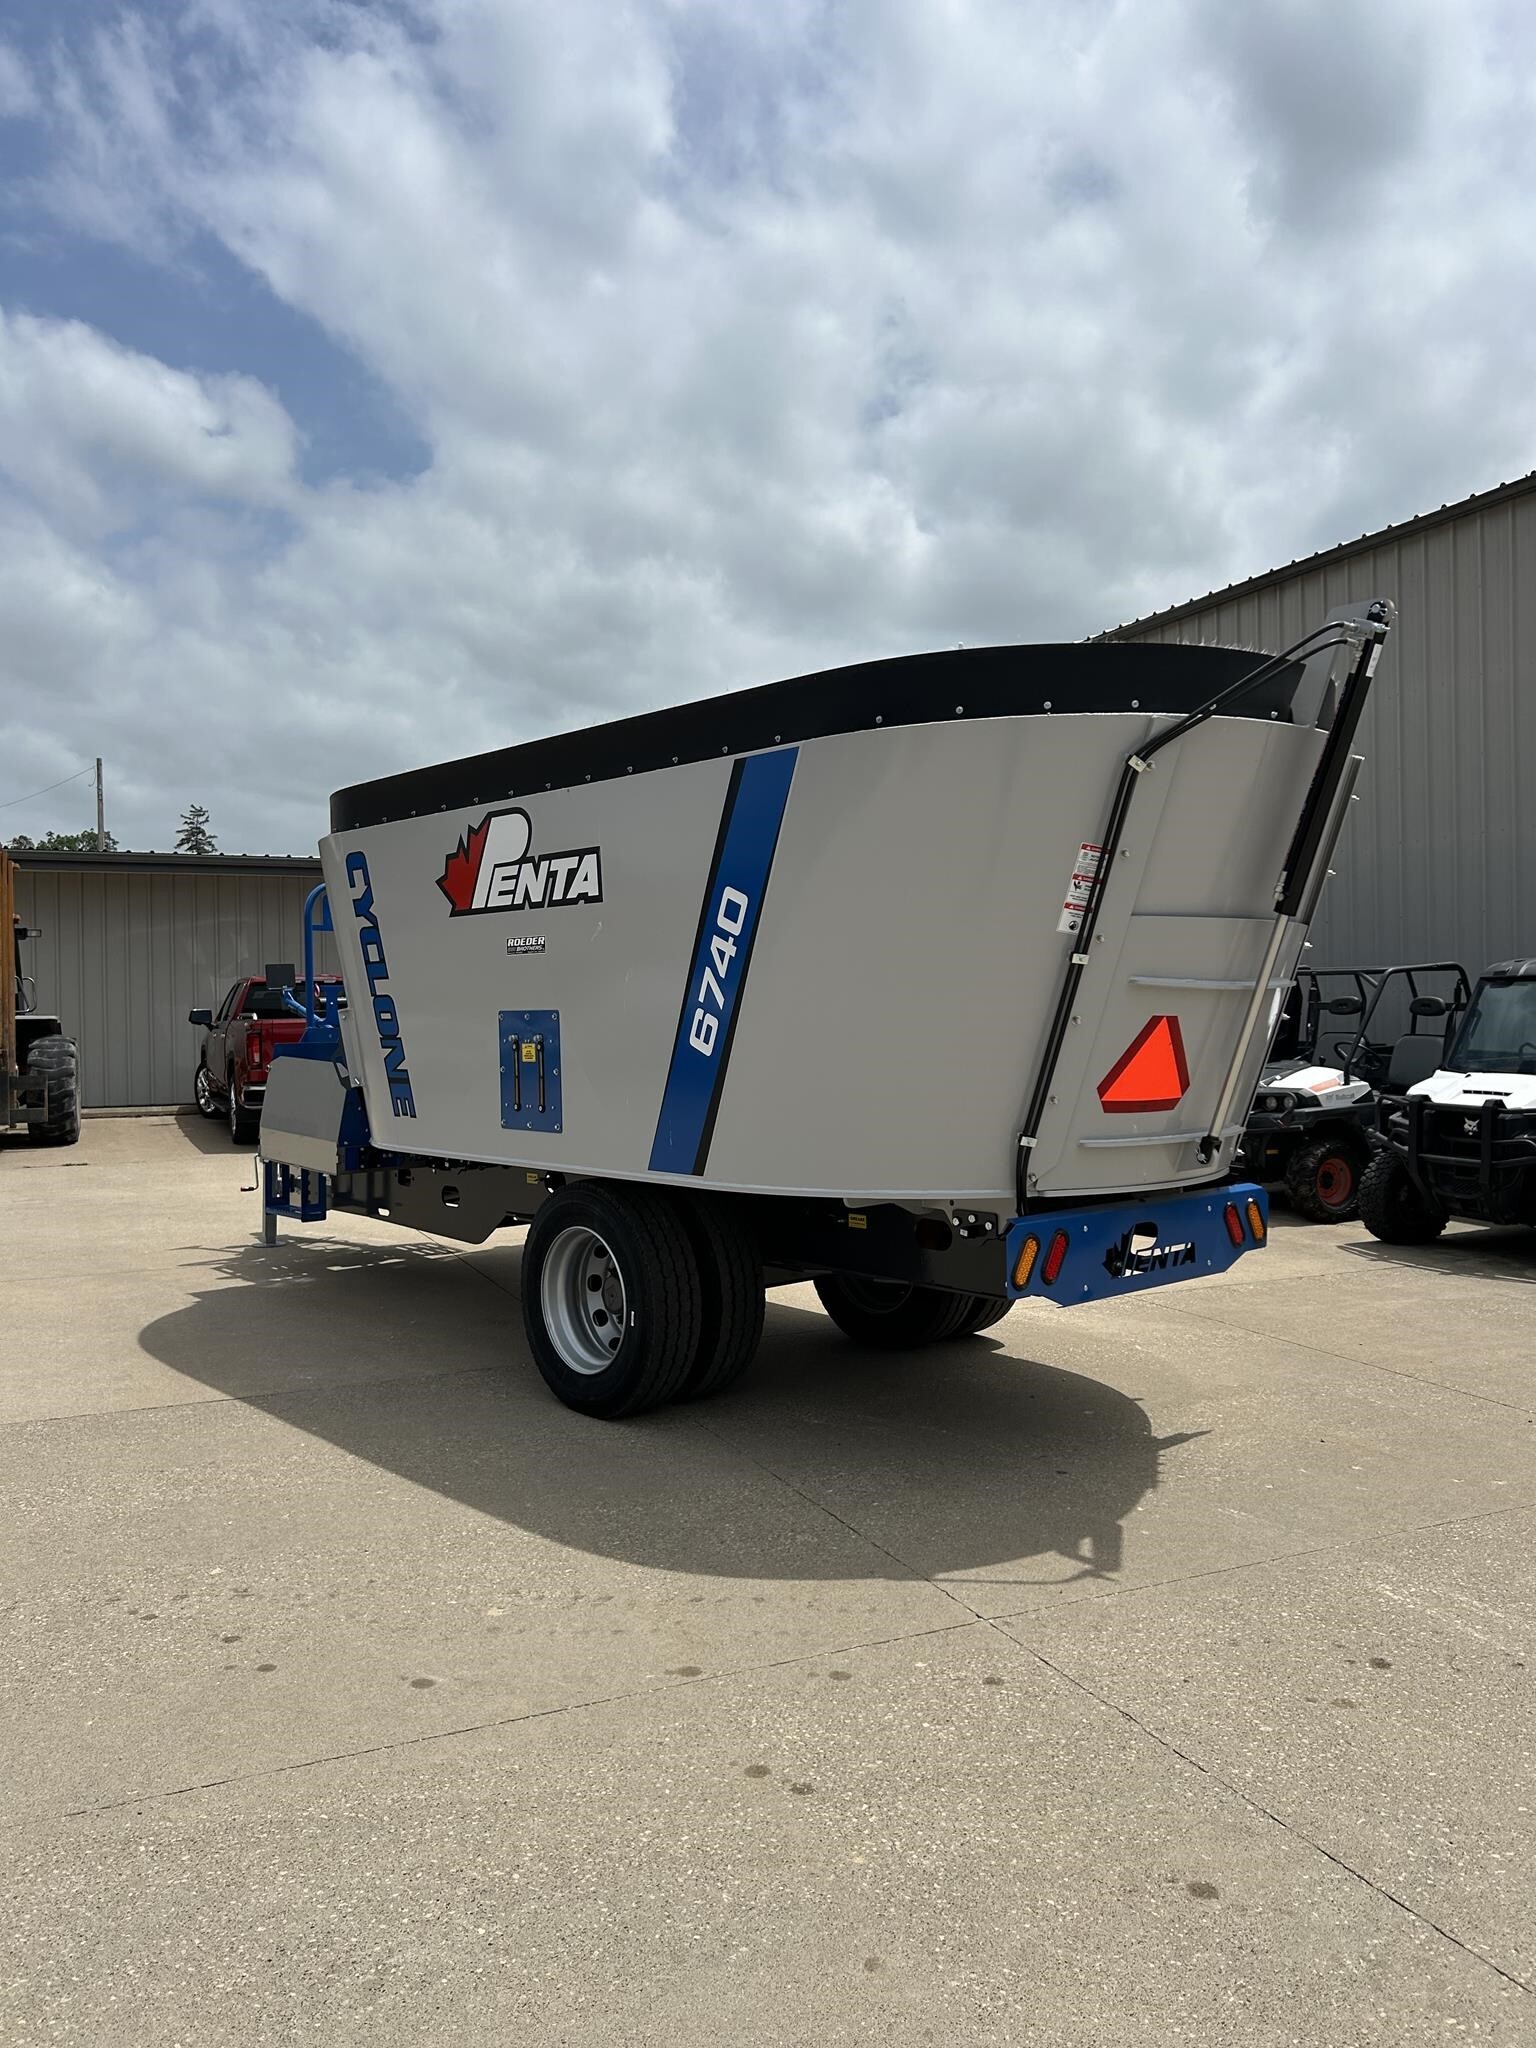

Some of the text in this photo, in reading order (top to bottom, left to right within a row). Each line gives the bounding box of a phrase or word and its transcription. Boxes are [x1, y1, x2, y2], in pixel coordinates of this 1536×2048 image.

[470, 812, 600, 910] PENTA
[346, 850, 417, 1119] CYCLONE
[507, 936, 545, 947] ROEDER
[689, 886, 749, 1057] 6740
[1121, 1221, 1196, 1277] PENTA
